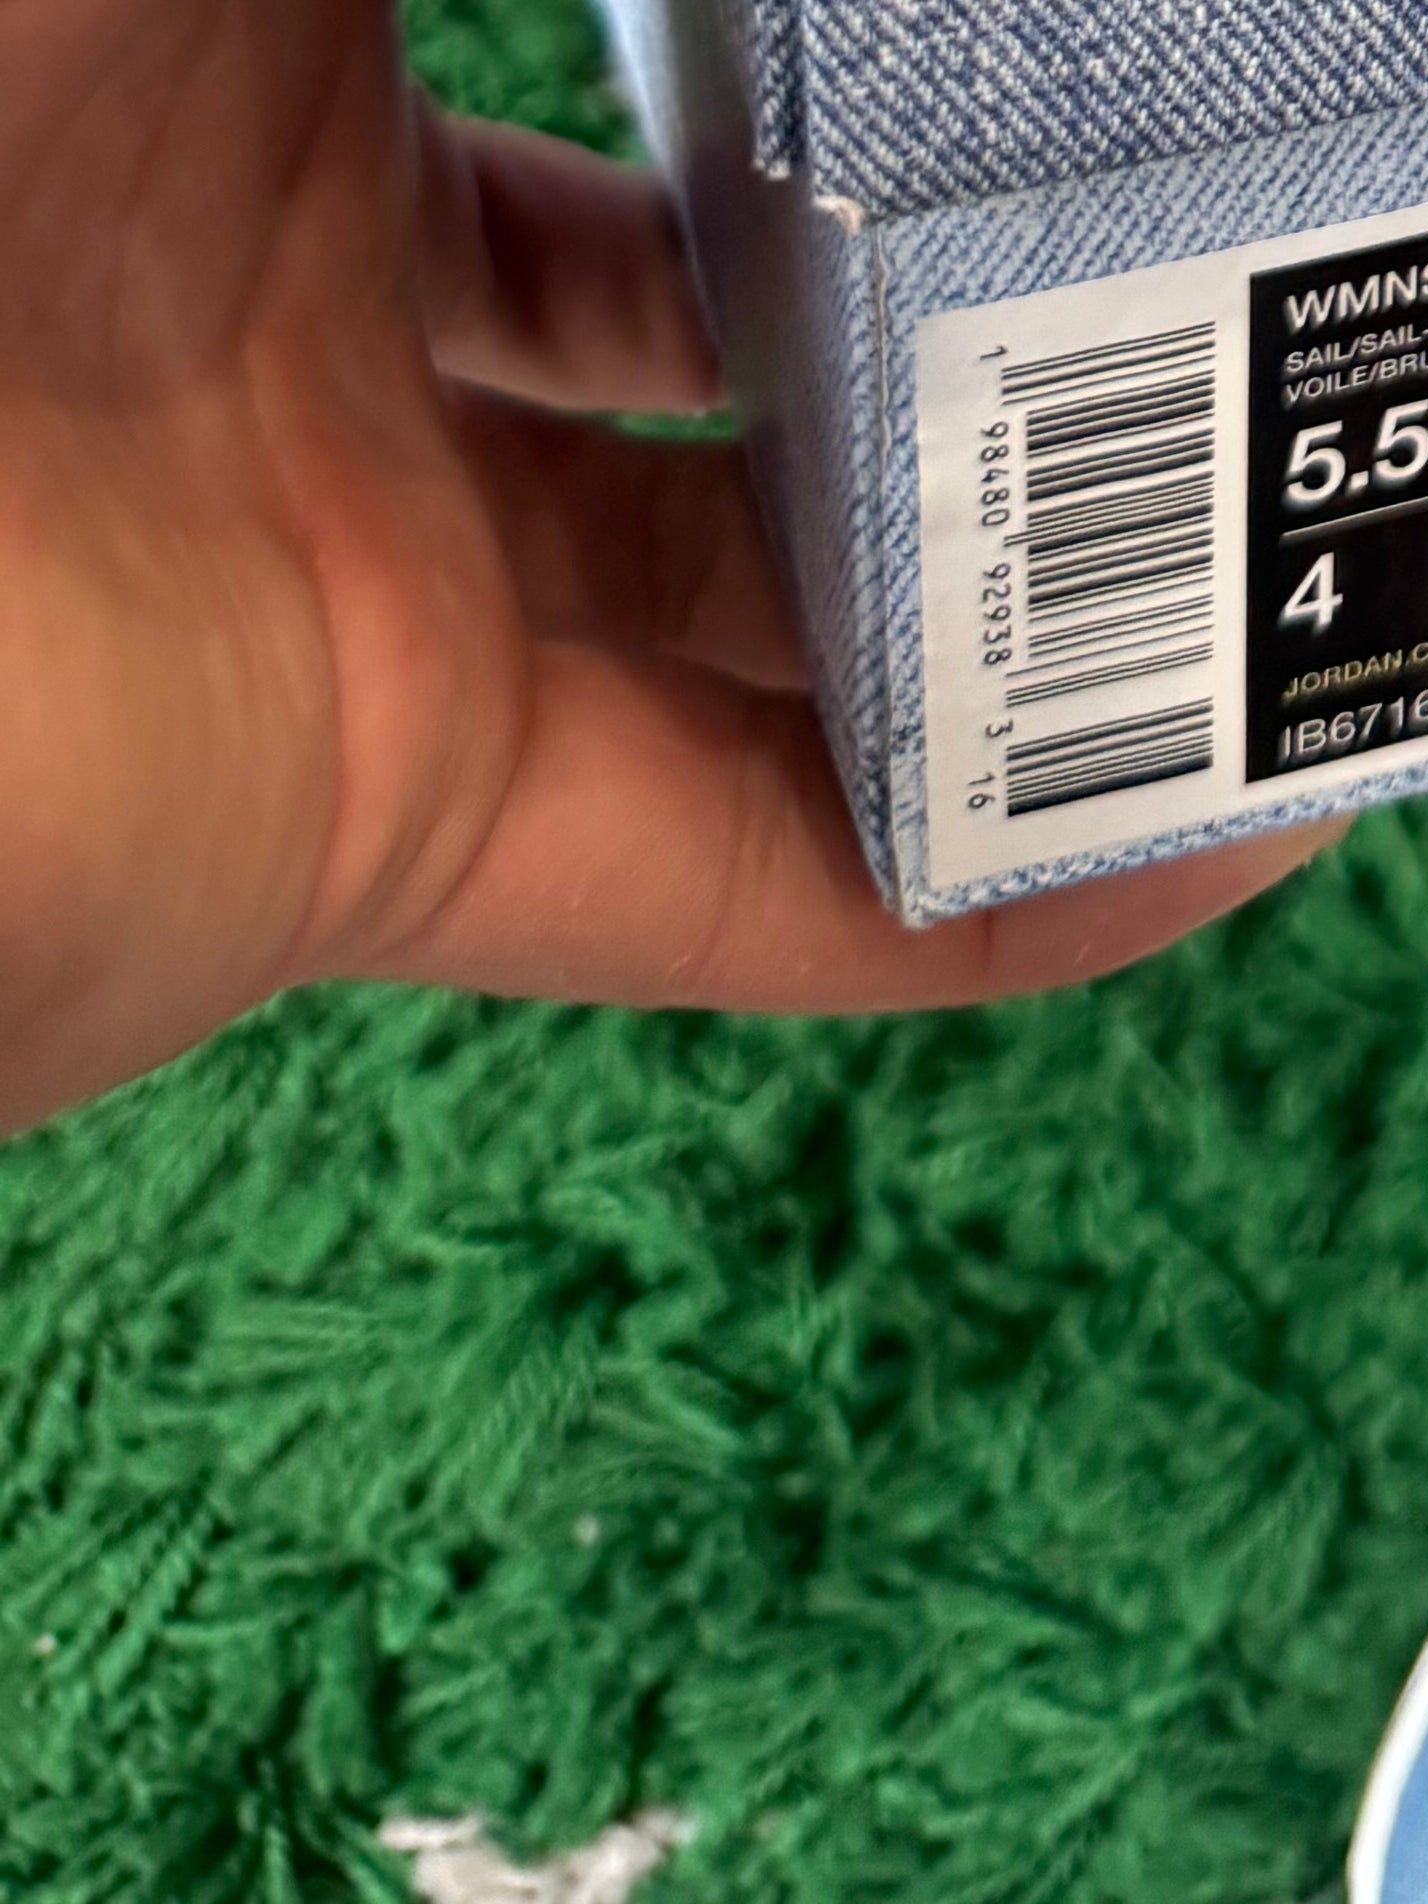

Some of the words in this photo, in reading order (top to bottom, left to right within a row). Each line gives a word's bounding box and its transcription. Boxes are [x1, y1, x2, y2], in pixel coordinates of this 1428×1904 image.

[980, 345, 1008, 363] 1
[980, 421, 1010, 528] 98480
[982, 562, 1011, 666] 92938
[1280, 552, 1343, 634] 4
[985, 718, 1013, 738] 3
[968, 772, 996, 811] 16
